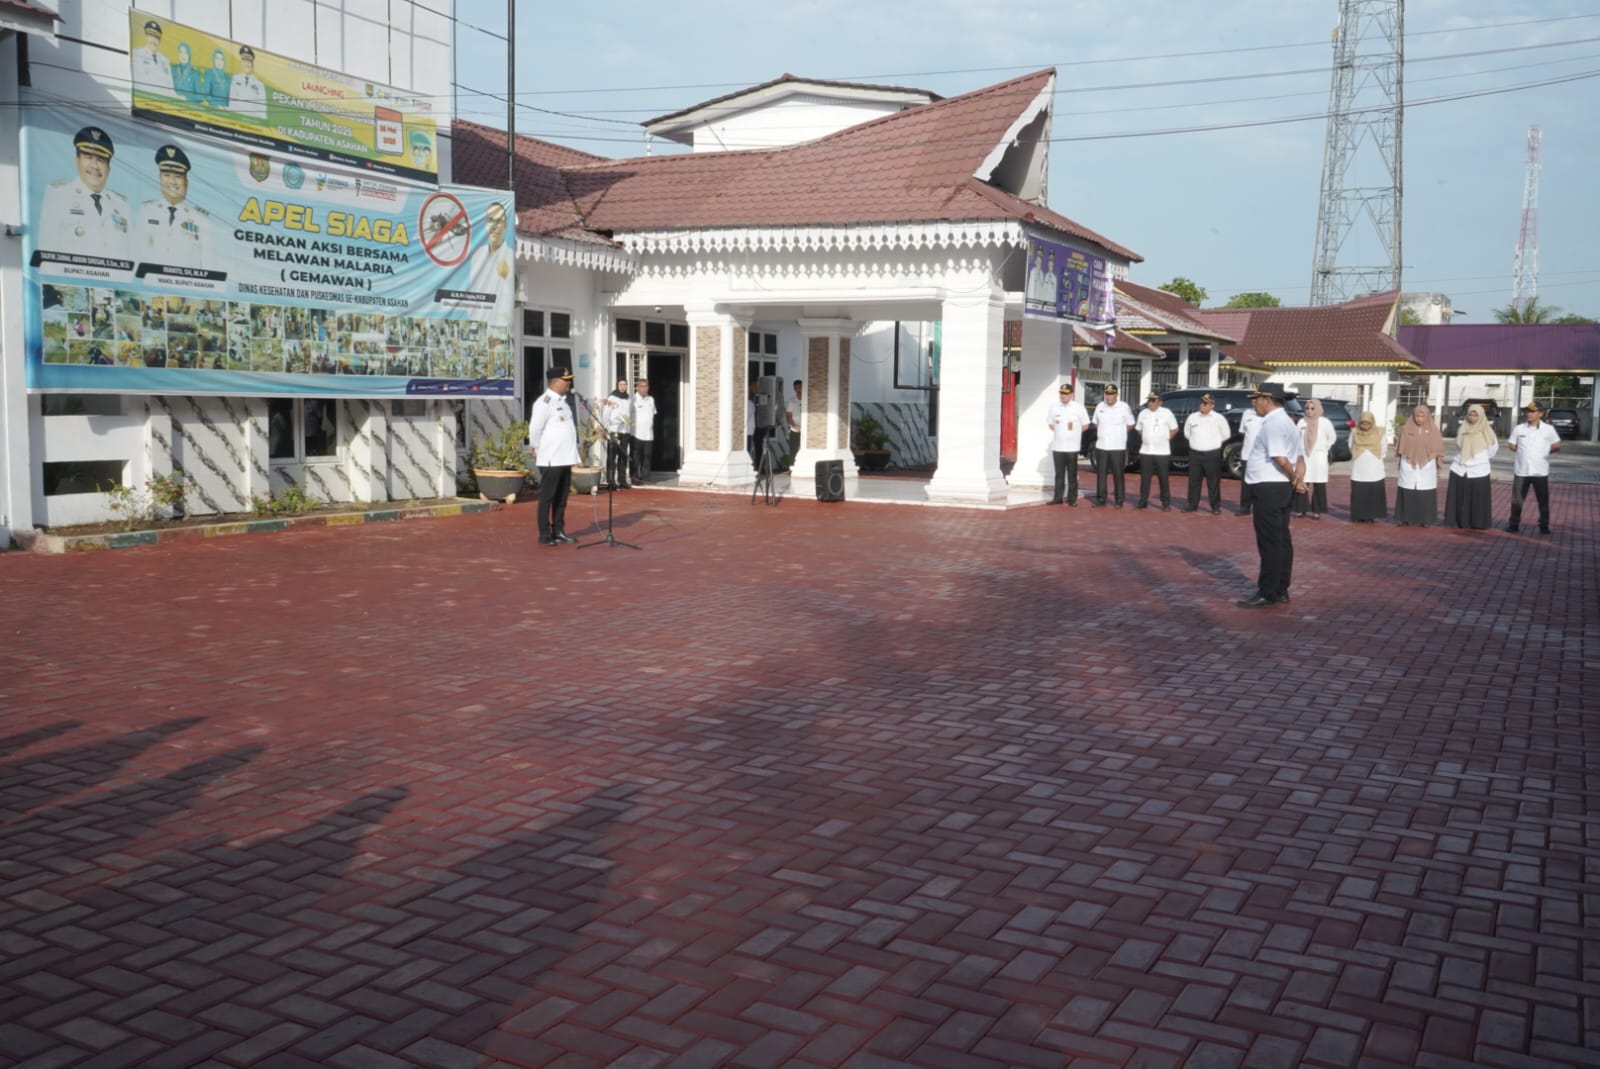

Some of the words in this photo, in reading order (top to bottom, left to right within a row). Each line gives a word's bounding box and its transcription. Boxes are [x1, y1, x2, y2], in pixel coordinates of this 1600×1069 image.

[272, 91, 304, 108] PEKAN
[302, 81, 344, 99] LAUNCHING
[299, 115, 331, 132] TAHUN
[331, 124, 353, 137] 2025
[287, 127, 335, 147] KABUPATEN
[336, 139, 368, 153] ASAHAN
[239, 196, 321, 233] APEL
[326, 210, 409, 246] SIAGA
[233, 229, 307, 249] GERAKAN
[310, 240, 343, 255] AKSI
[346, 245, 409, 263] BERSAMA
[86, 269, 110, 277] ASAHAN
[253, 248, 330, 268] MELAWAN
[334, 258, 395, 275] MALARIA
[290, 270, 364, 289] GEMAWAN
[238, 282, 258, 294] DINAS
[259, 285, 295, 297] KESEHATAN
[296, 288, 310, 299] DAN
[310, 290, 345, 302] PUSKESMAS
[387, 297, 409, 308] ASAHAN
